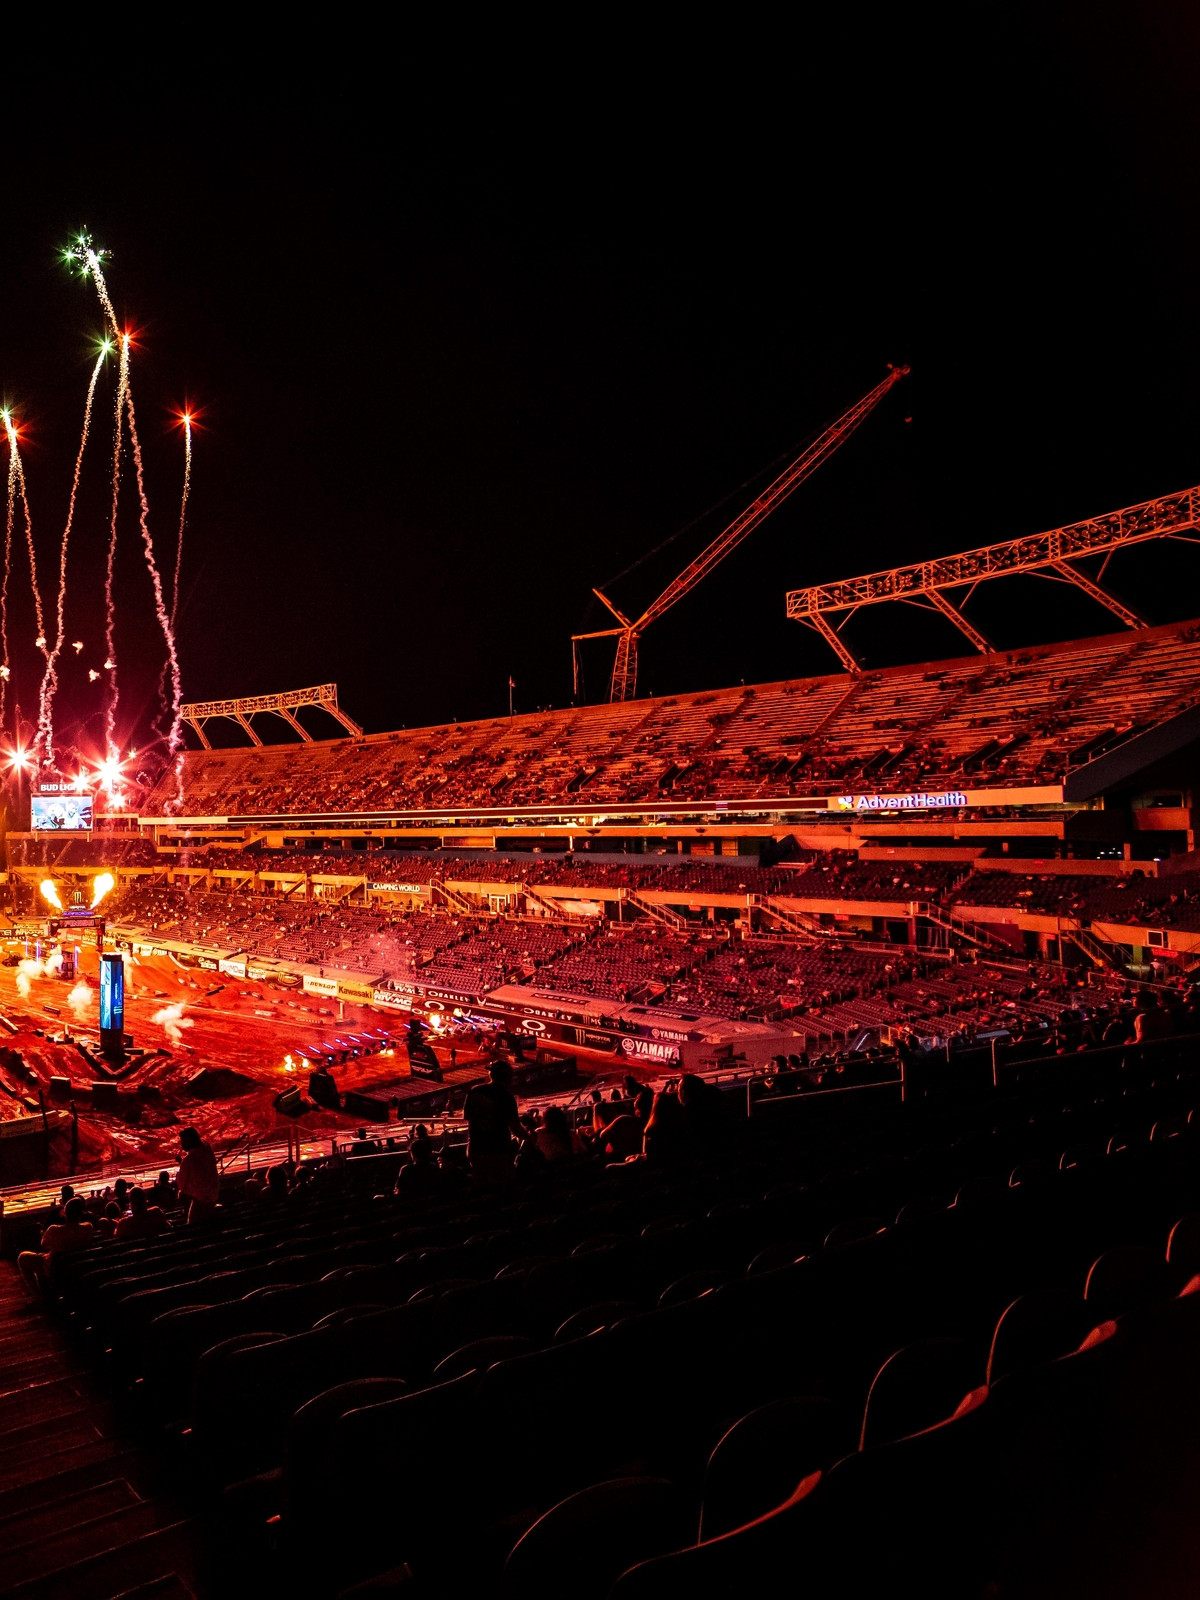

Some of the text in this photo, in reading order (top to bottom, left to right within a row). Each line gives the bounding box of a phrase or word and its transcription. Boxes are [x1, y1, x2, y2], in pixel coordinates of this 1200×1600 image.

[40, 783, 59, 792] BUD
[857, 791, 967, 809] AdventHealth
[373, 883, 420, 893] CAMPING WORLD
[309, 981, 336, 990] DUNLOP
[338, 985, 372, 999] Kawasaki
[438, 992, 469, 1003] OAKLEY
[534, 1009, 573, 1021] OAKEY
[516, 1027, 552, 1039] OAKLEY
[659, 1030, 689, 1041] YAMAHA
[635, 1041, 680, 1060] YAMAHA
